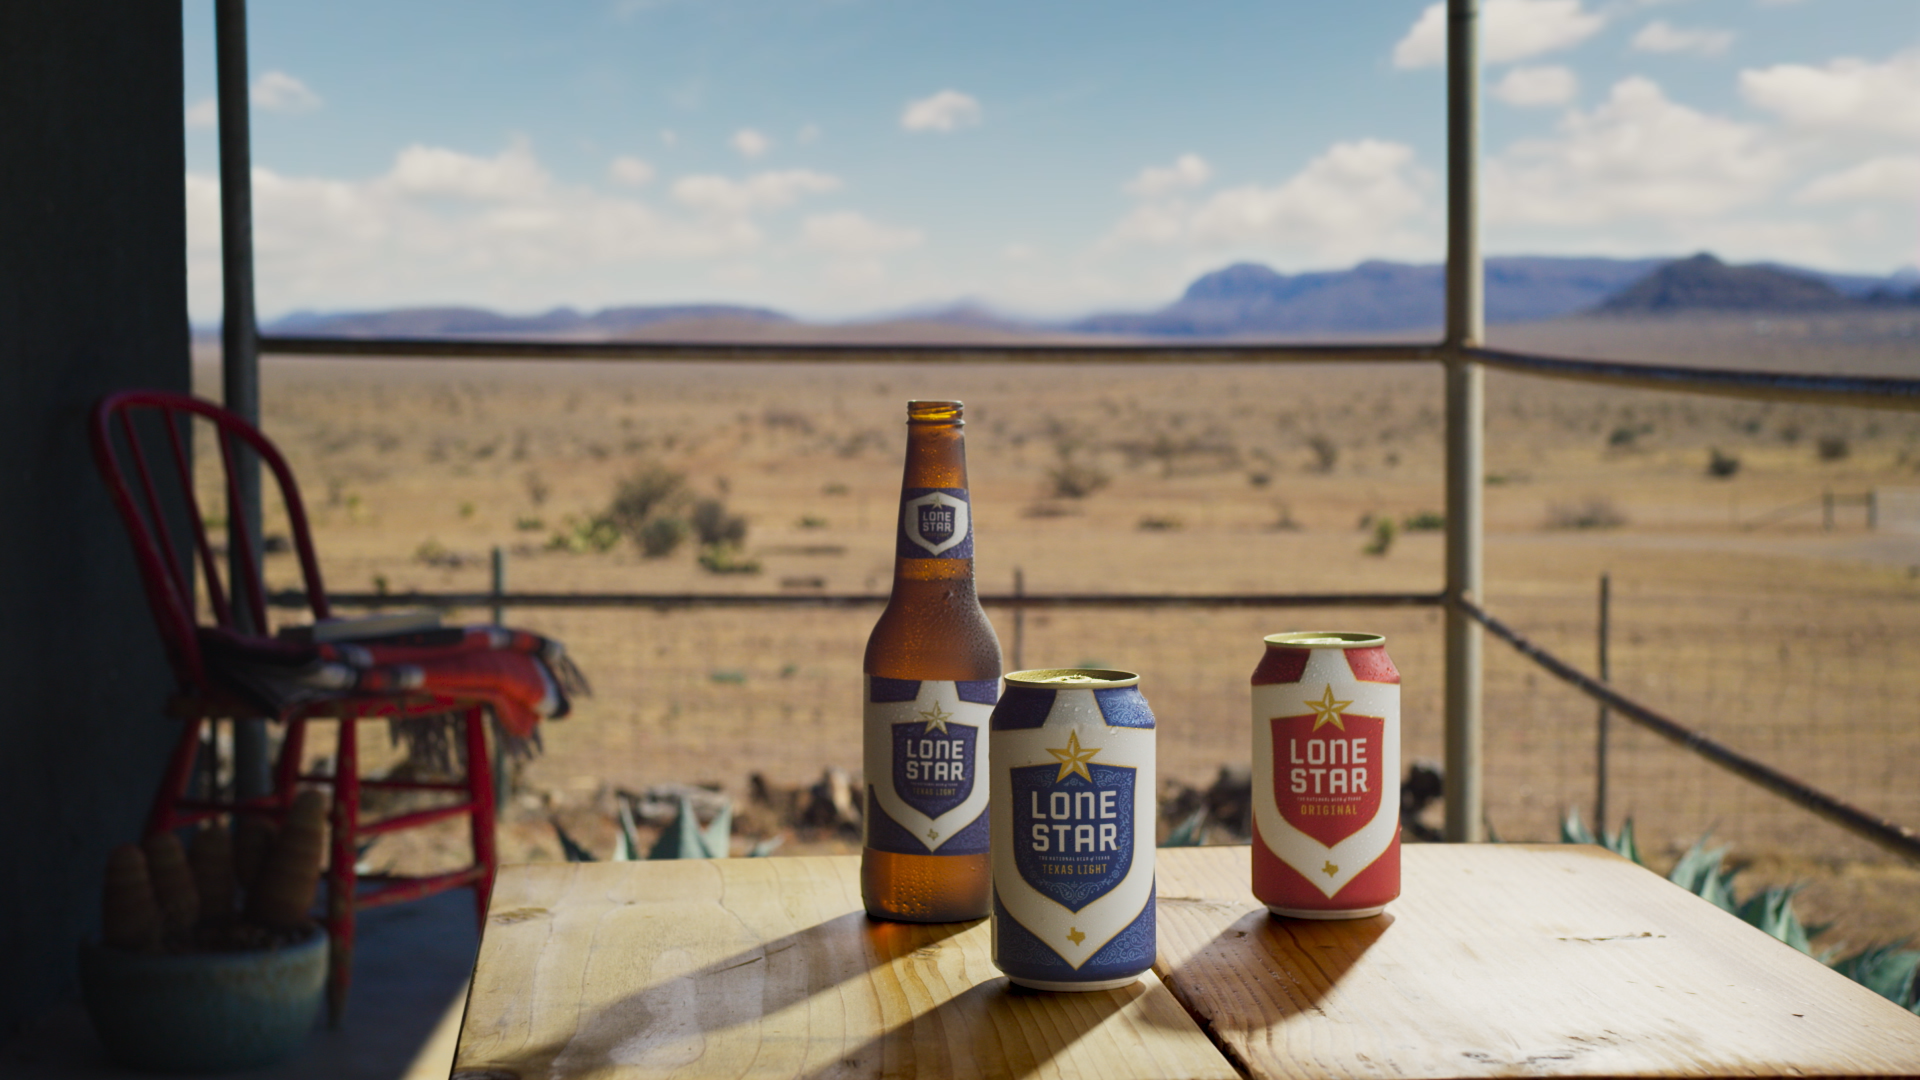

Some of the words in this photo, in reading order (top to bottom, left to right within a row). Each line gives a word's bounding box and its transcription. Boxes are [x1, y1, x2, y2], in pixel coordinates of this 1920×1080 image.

[923, 511, 952, 522] LONE
[923, 522, 952, 532] STAR
[906, 739, 964, 760] LONE
[1290, 738, 1367, 764] LONE
[906, 761, 965, 781] STAR
[1290, 767, 1368, 794] STAR
[936, 788, 956, 796] LIGHT
[1032, 791, 1117, 820] LONE
[1301, 804, 1358, 815] ORIGINAL
[1032, 823, 1118, 853] STAR
[1042, 863, 1073, 875] TEXAS
[1077, 863, 1107, 875] LIGHT
